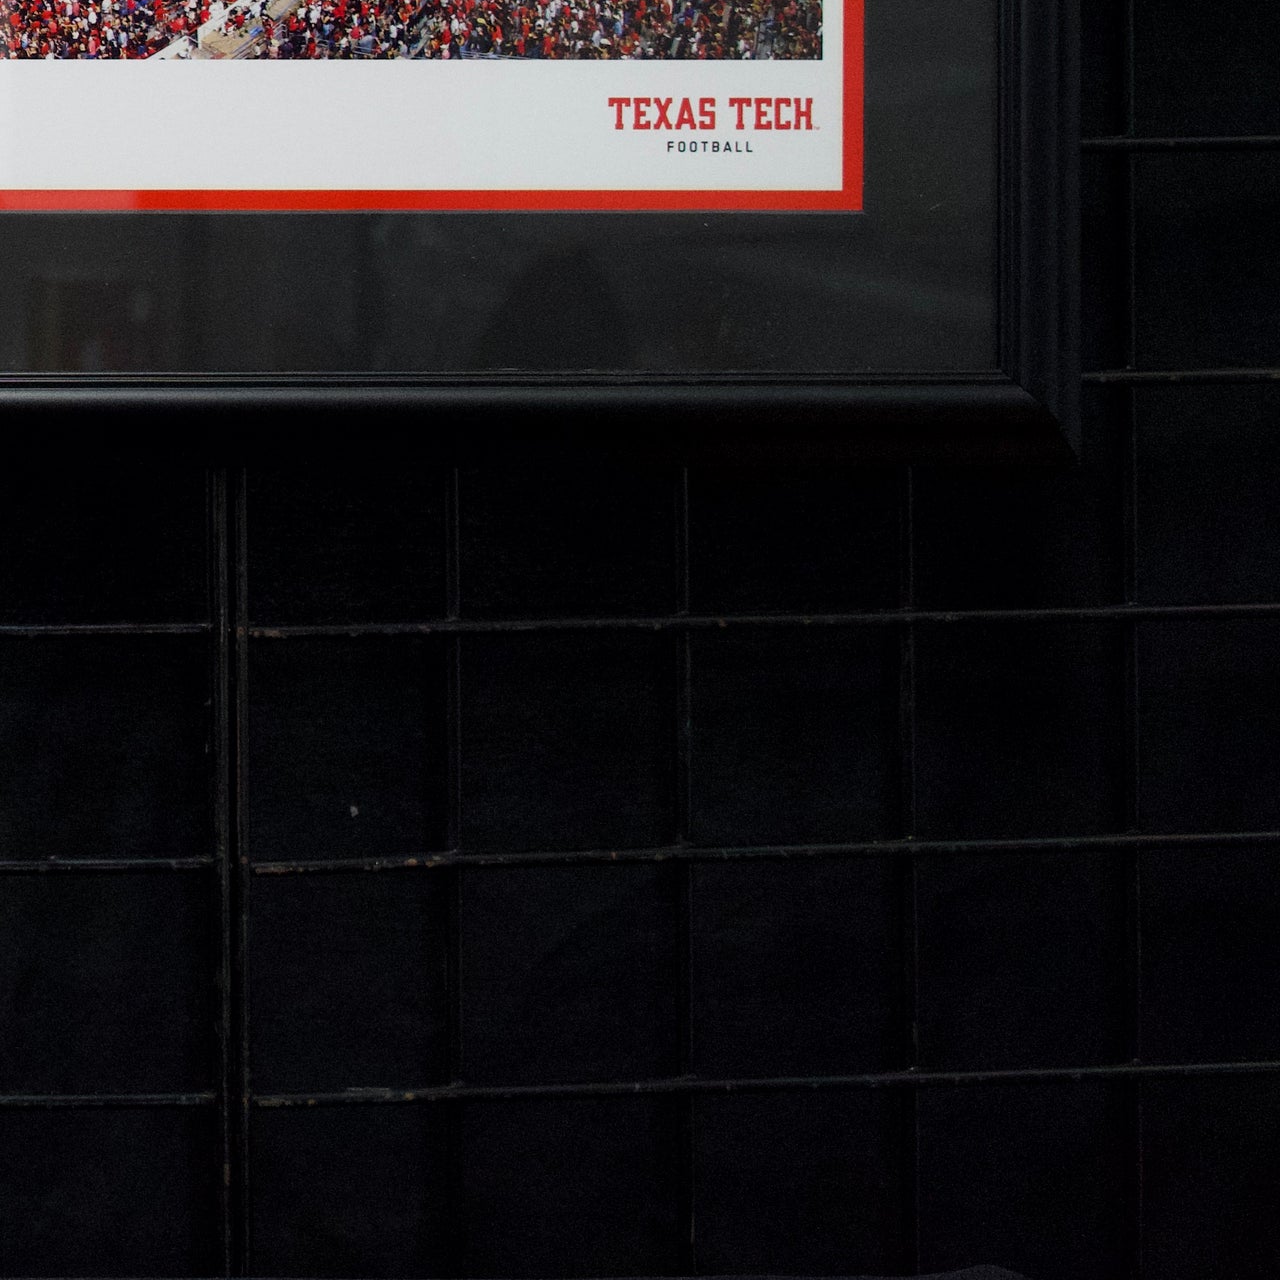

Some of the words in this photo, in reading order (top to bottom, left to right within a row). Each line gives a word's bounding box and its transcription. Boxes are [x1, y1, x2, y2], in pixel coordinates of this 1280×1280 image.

[608, 97, 716, 130] TEXAS
[729, 97, 813, 130] TECH
[667, 141, 753, 153] FOOTBALL
